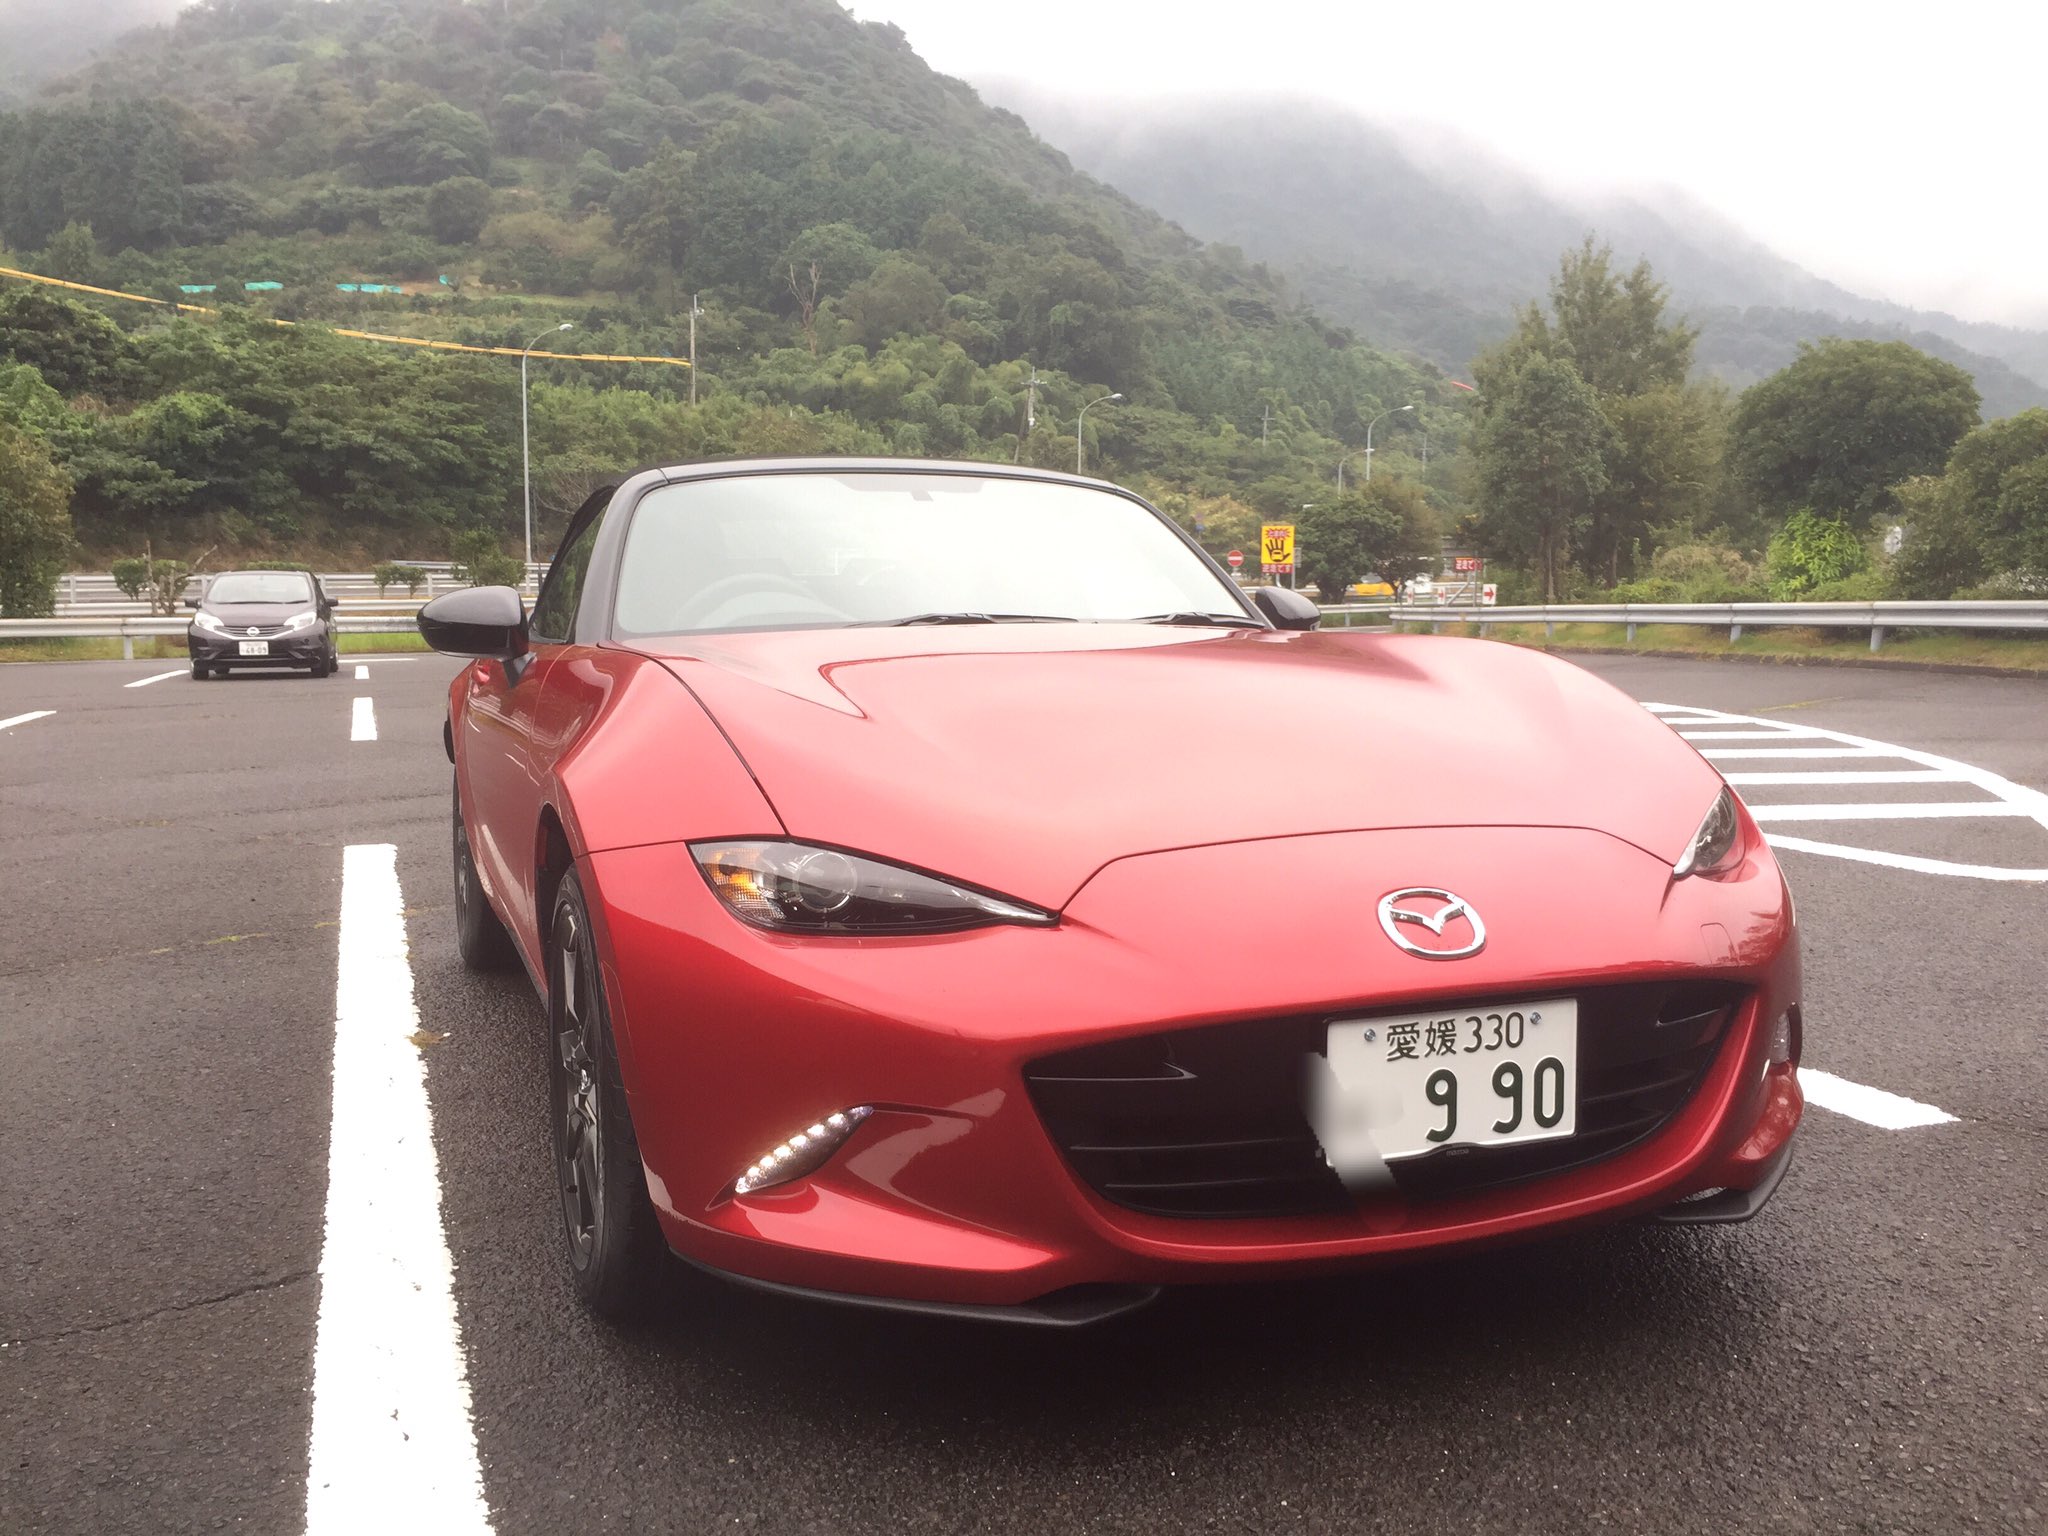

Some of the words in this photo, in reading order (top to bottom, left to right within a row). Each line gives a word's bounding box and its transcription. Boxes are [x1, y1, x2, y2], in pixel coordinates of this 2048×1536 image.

[1386, 1018, 1457, 1062] 愛媛
[1463, 1011, 1524, 1054] 330
[1425, 1068, 1457, 1142] 9
[1492, 1056, 1565, 1134] 90
